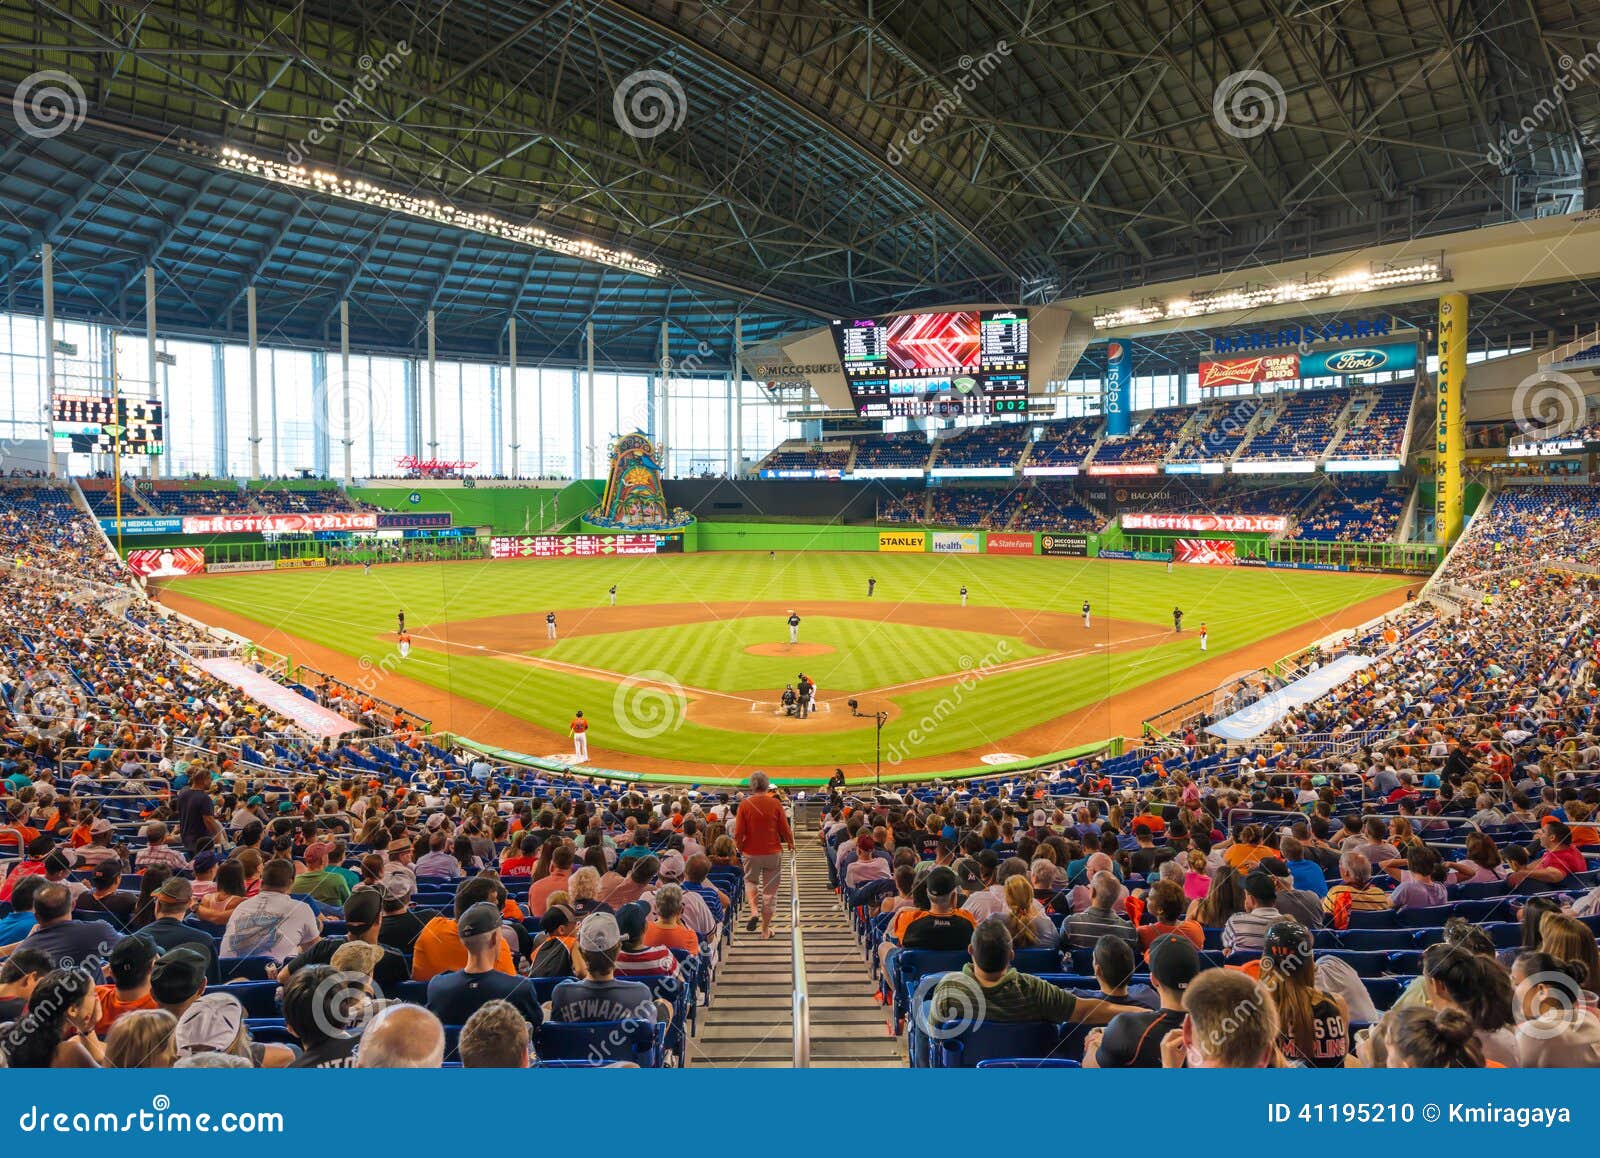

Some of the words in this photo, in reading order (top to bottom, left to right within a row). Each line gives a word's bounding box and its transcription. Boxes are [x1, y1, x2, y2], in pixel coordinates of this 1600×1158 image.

[1214, 326, 1314, 353] MARLINS
[1324, 319, 1390, 342] PARK
[1265, 356, 1294, 367] GRAB
[1336, 352, 1376, 370] Ford
[1265, 369, 1294, 379] BUDS
[1108, 366, 1121, 413] pepsi
[996, 401, 1003, 410] 0
[1008, 401, 1014, 410] 0
[1018, 401, 1025, 410] 2
[138, 482, 153, 490] 401
[410, 494, 420, 502] 42
[880, 538, 924, 546] STANLEY
[935, 542, 962, 550] Health
[509, 864, 531, 876] HEYWA
[1326, 1016, 1344, 1038] GO
